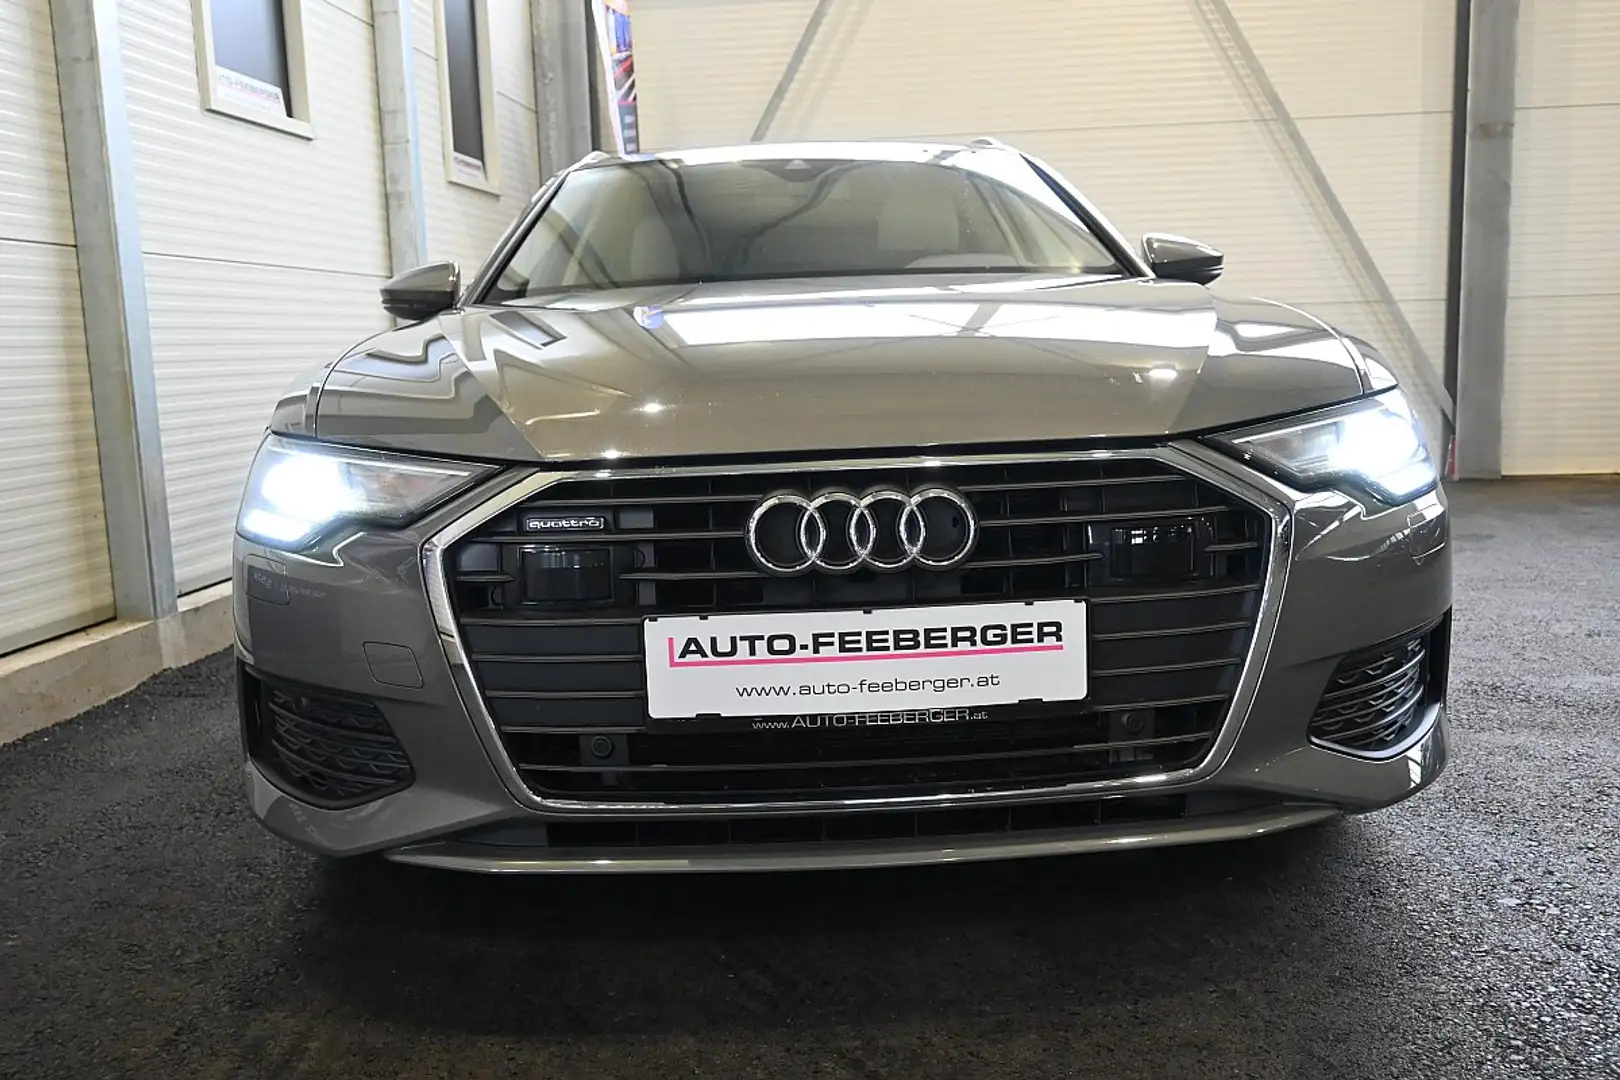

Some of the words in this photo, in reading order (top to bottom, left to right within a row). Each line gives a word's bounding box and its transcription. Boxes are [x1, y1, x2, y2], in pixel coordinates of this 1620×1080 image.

[529, 519, 600, 527] quattro
[678, 620, 1063, 659] AUTO-FEEBERGER
[735, 672, 1001, 699] www.auto-feeberger.at
[752, 707, 989, 730] www.AUTO-FEEBERGER.at
